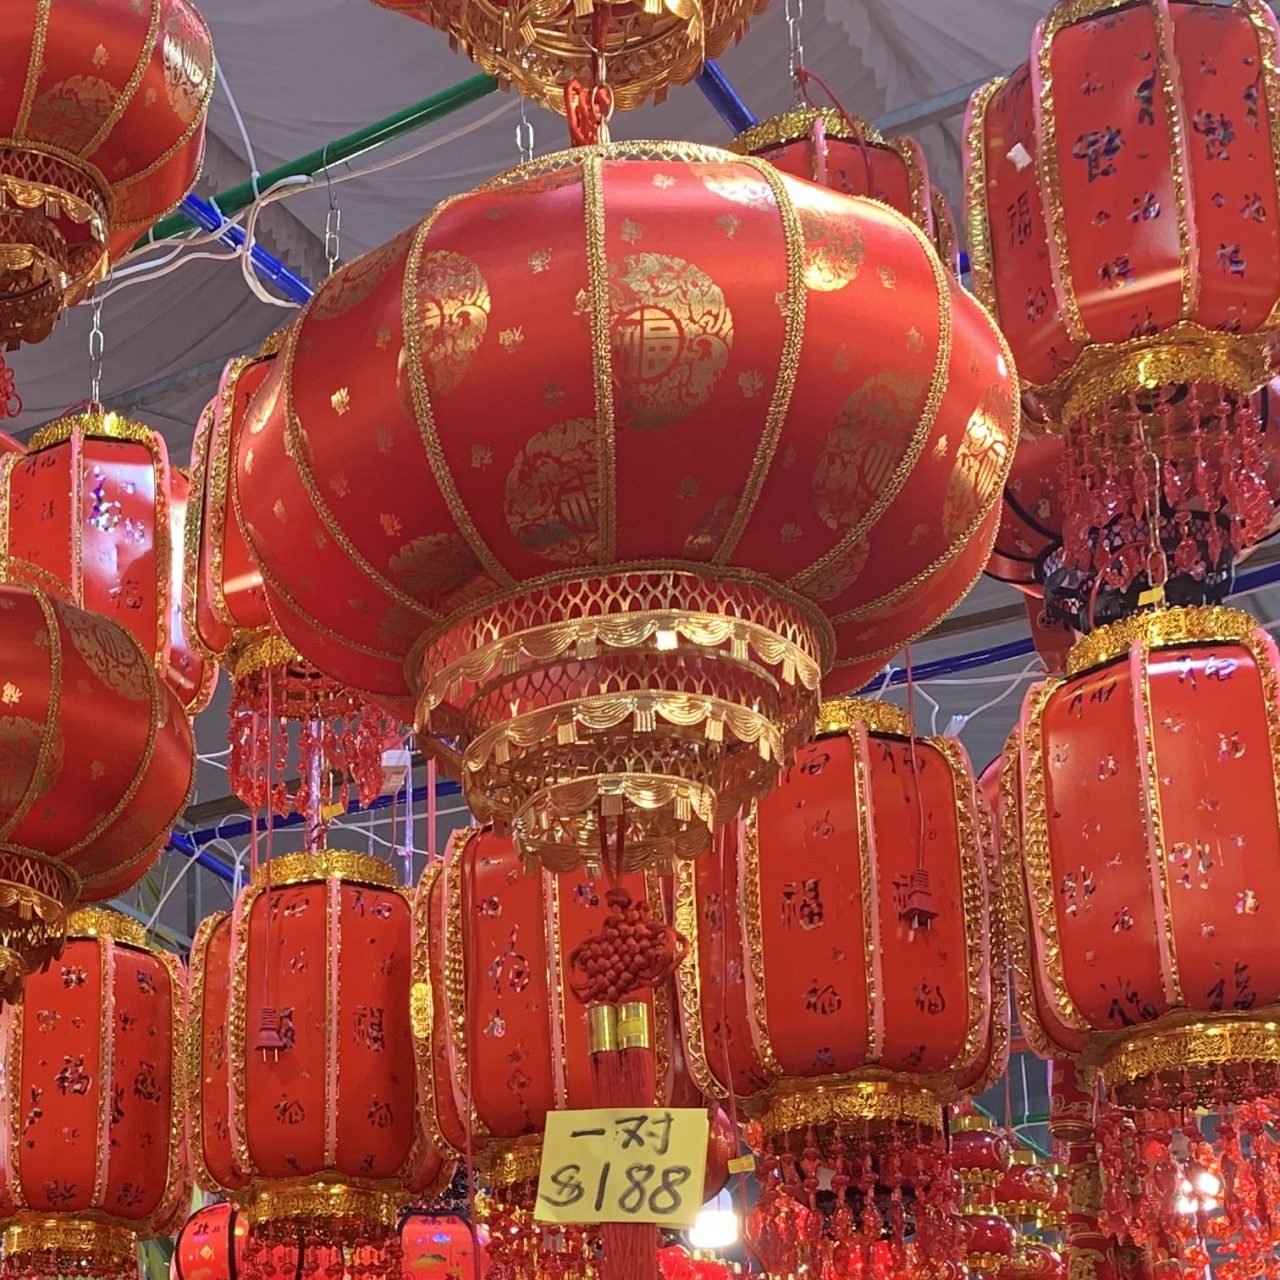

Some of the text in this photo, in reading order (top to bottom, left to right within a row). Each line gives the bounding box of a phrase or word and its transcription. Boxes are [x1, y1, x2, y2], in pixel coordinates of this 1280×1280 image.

[616, 306, 680, 379] 福
[570, 1112, 674, 1156] 一对
[539, 1161, 692, 1214] $188
